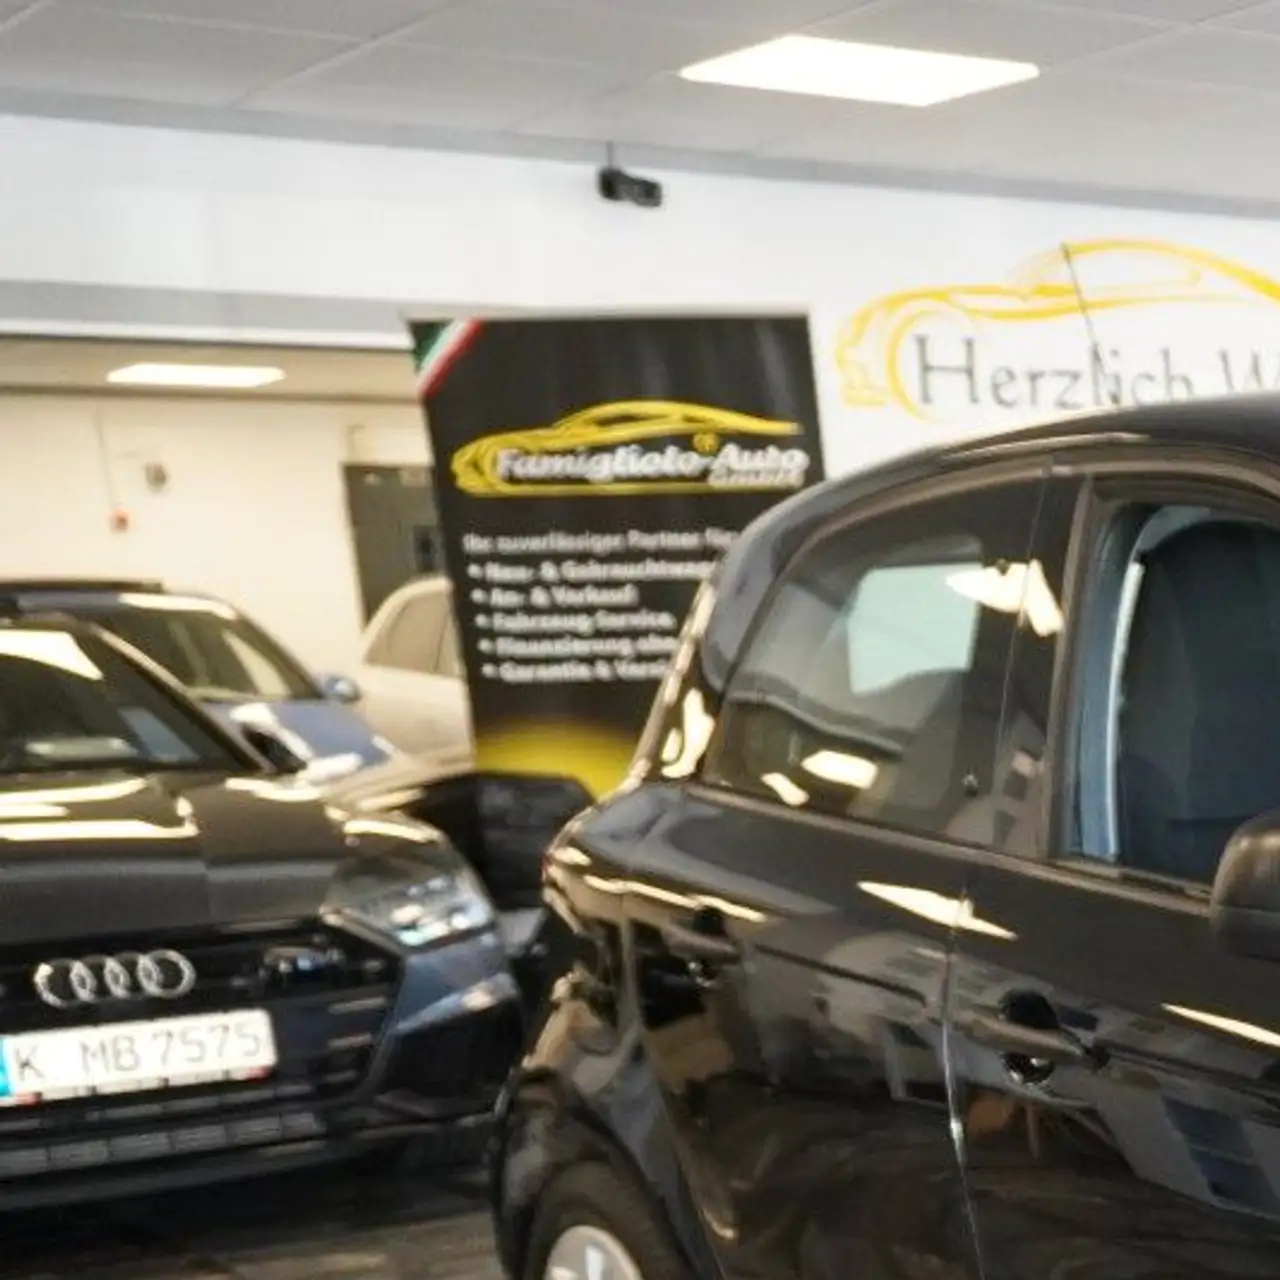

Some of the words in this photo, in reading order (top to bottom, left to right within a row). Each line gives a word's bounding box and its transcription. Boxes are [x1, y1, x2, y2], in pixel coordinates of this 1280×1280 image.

[913, 333, 1195, 409] Herzlich
[626, 528, 702, 552] Partner
[12, 1045, 45, 1082] K
[78, 1033, 142, 1075] MB
[150, 1021, 261, 1067] 7575
